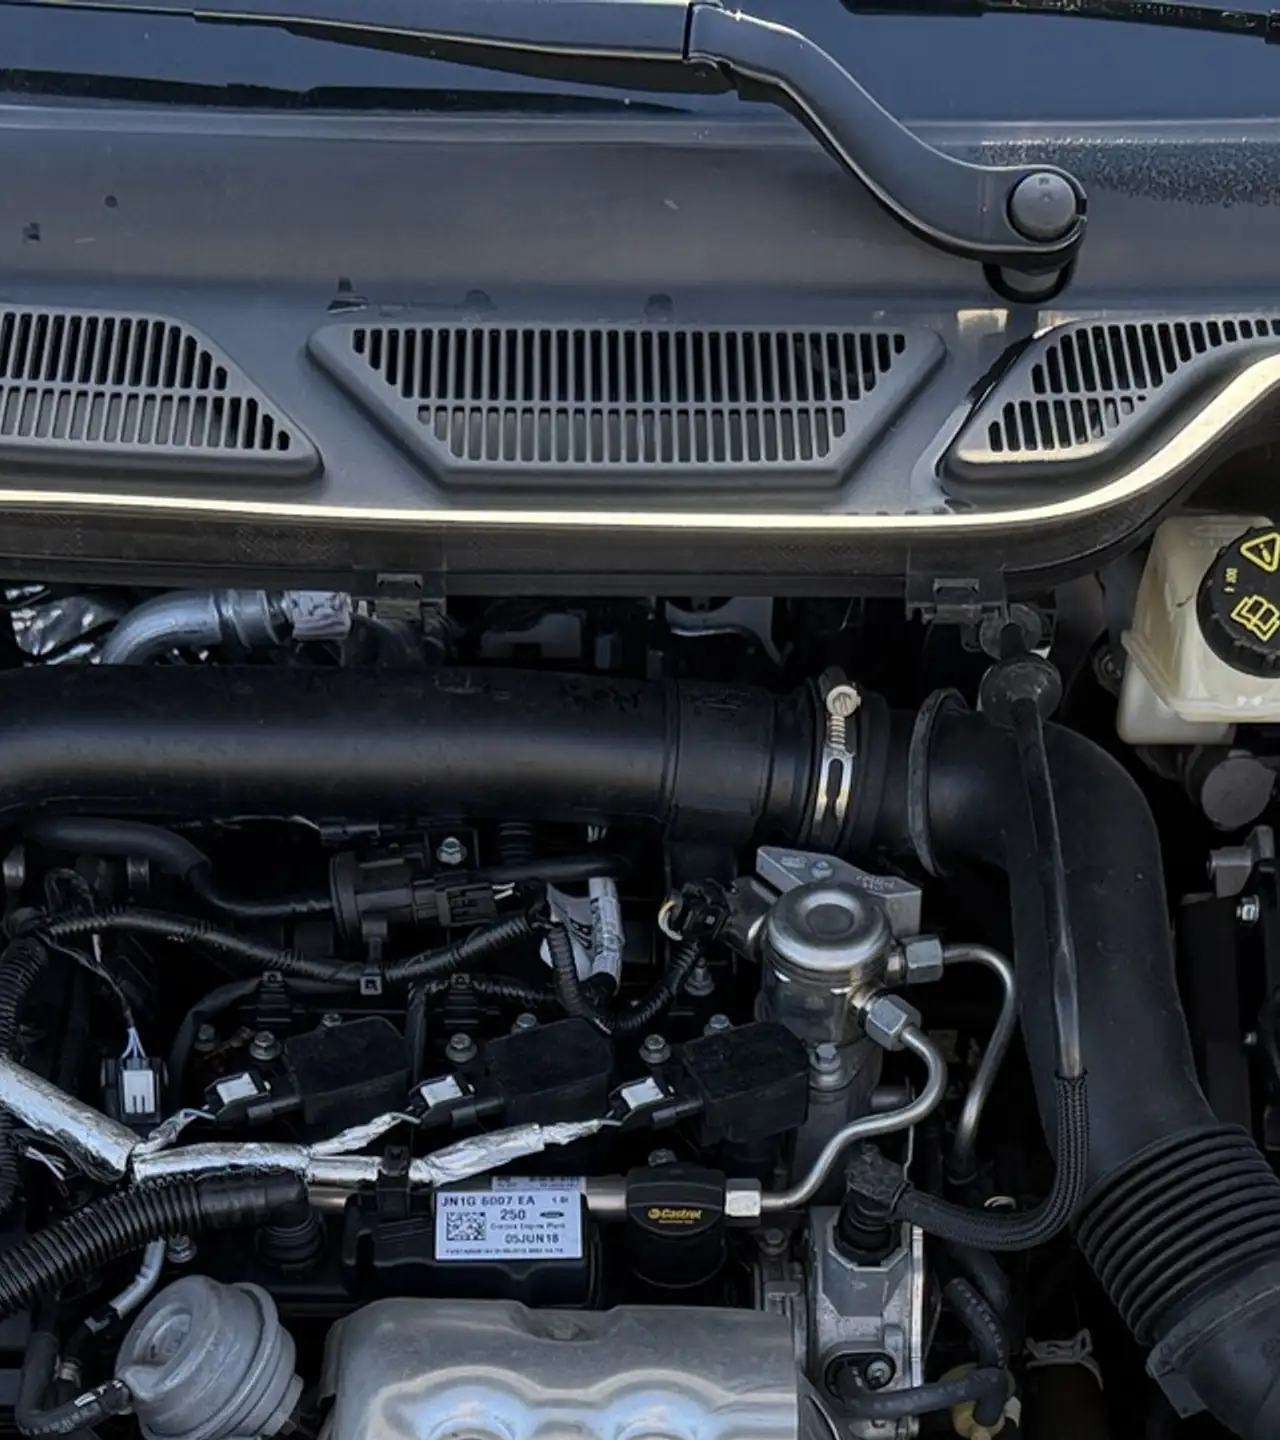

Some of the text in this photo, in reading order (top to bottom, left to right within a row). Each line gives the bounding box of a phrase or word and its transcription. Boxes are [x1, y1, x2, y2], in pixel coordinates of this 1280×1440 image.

[481, 1195, 513, 1206] 6007
[517, 1195, 536, 1206] EA
[499, 1208, 526, 1221] 250
[661, 1207, 703, 1220] Castrol
